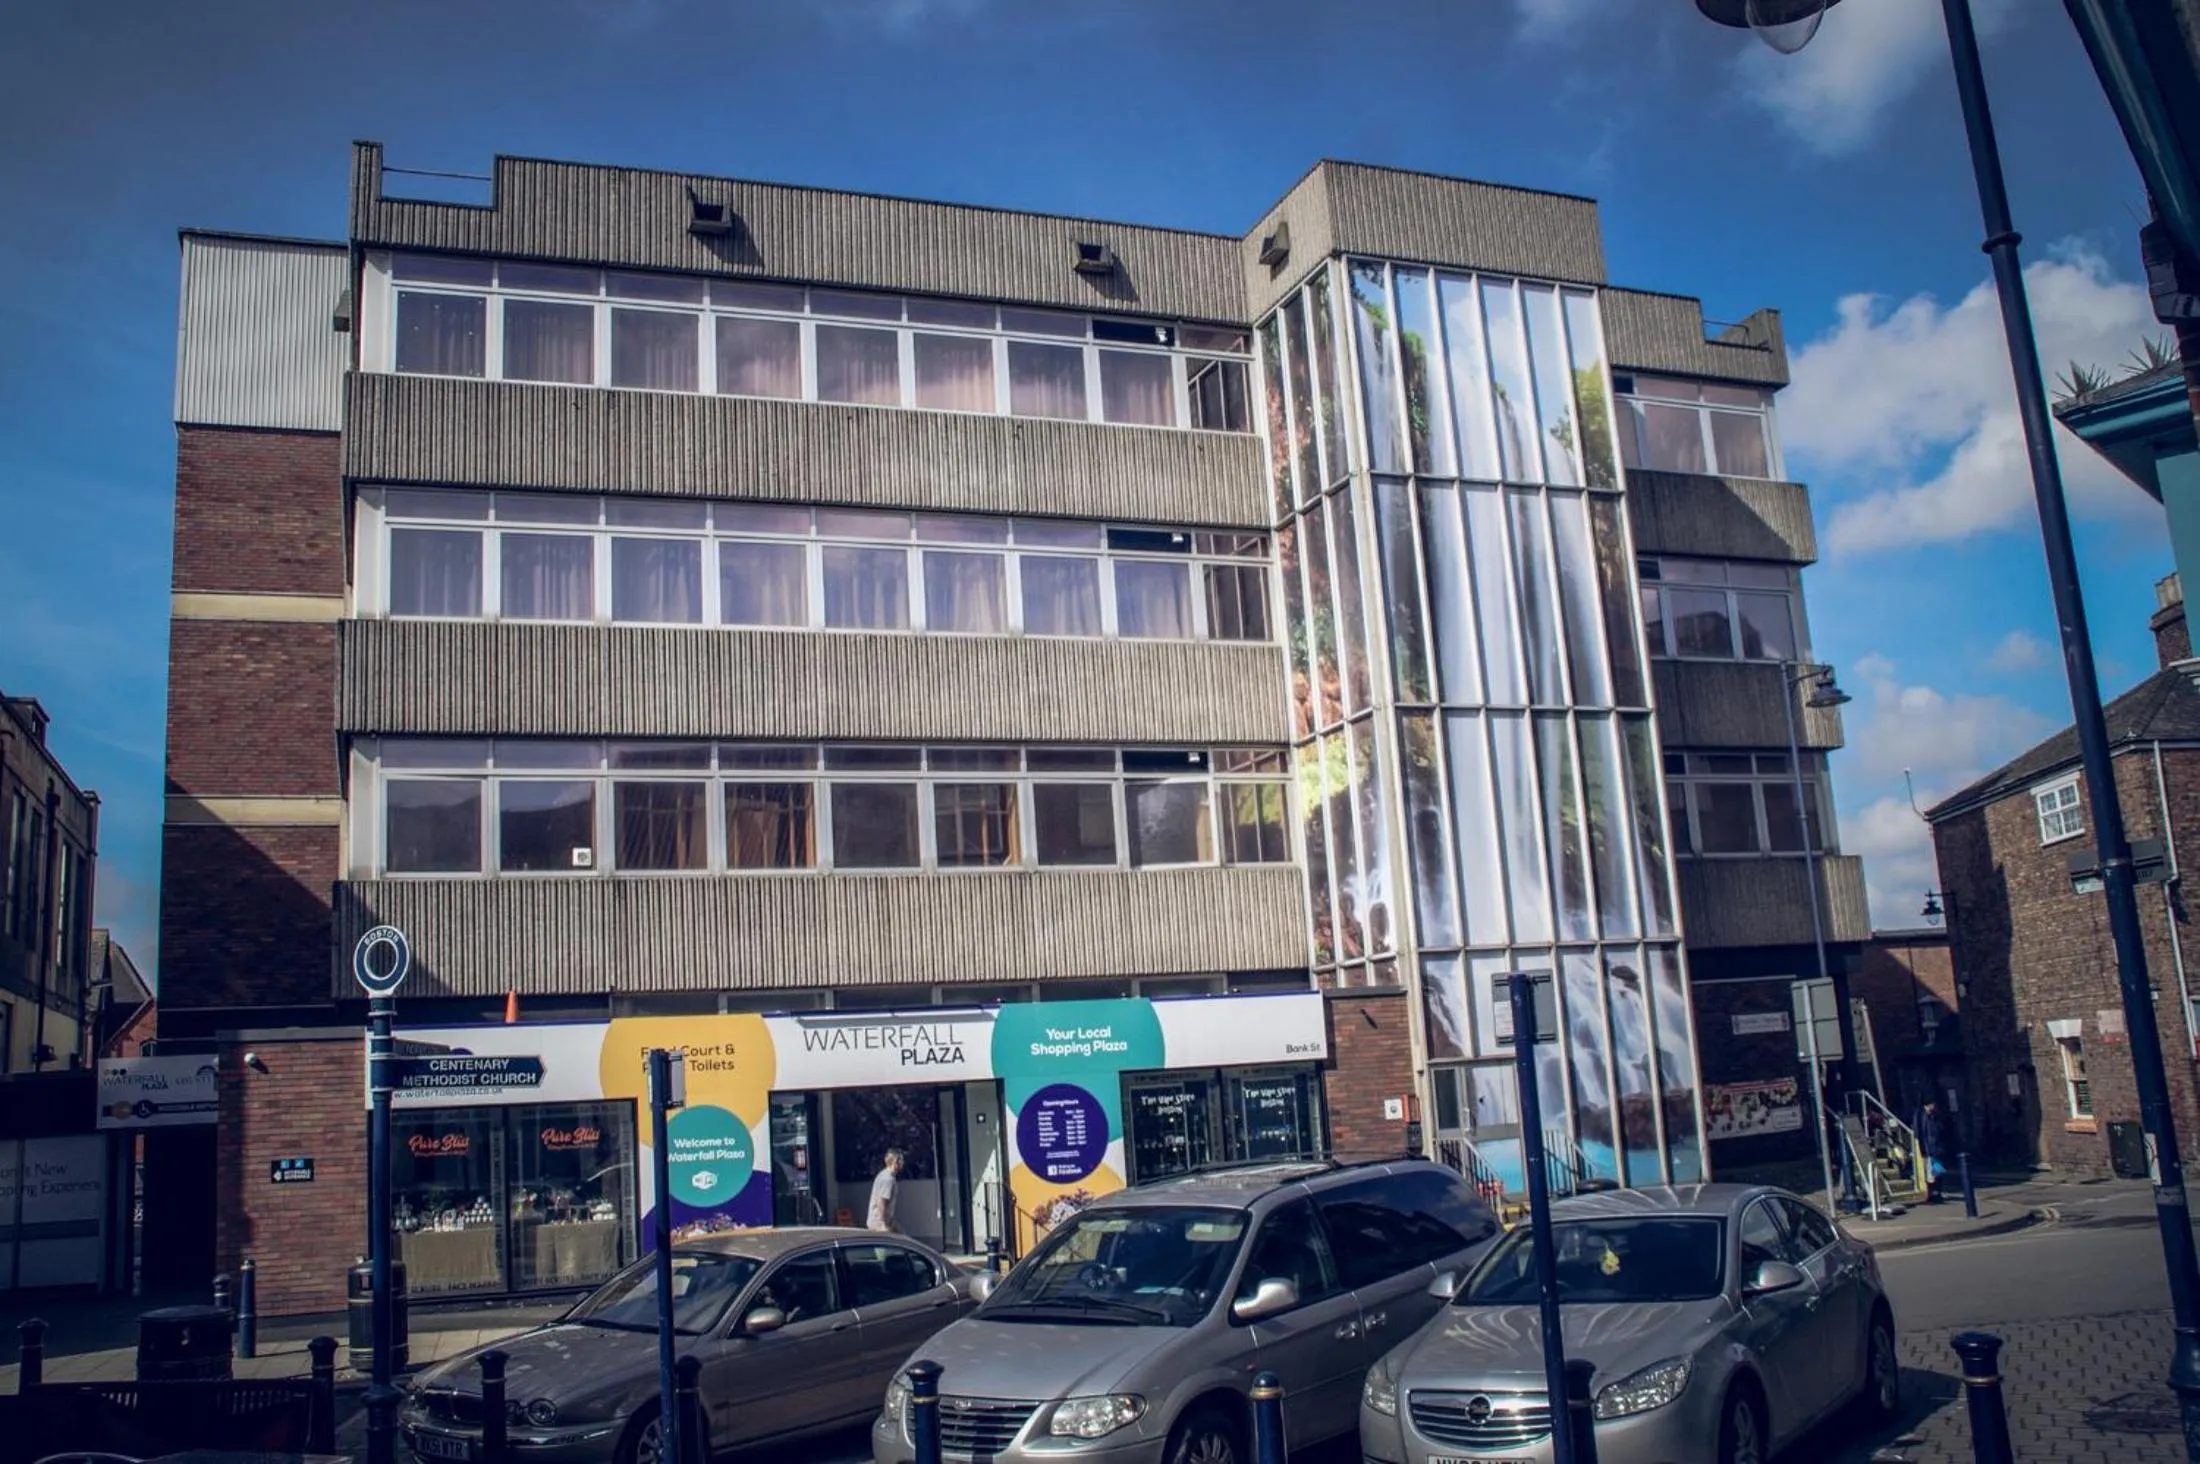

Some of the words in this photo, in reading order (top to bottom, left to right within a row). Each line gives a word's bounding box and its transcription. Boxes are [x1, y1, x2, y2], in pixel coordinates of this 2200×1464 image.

[363, 928, 400, 946] BOSTON
[803, 1023, 964, 1052] WATERFALL
[1046, 1028, 1075, 1040] Your
[1077, 1025, 1111, 1038] Local
[680, 1045, 720, 1057] Court
[725, 1043, 735, 1055] &
[1030, 1041, 1091, 1056] Shopping
[1093, 1040, 1128, 1052] Plaza
[1286, 1043, 1308, 1054] Bank
[901, 1047, 964, 1066] PLAZA
[429, 1059, 509, 1071] CENTENARY
[689, 1059, 735, 1072] Toilets
[402, 1074, 477, 1087] METHODIST
[480, 1072, 536, 1085] CHURCH
[408, 1134, 439, 1152] Pure
[674, 1137, 722, 1149] Welcome
[723, 1137, 736, 1146] to
[716, 1149, 745, 1160] Plaza
